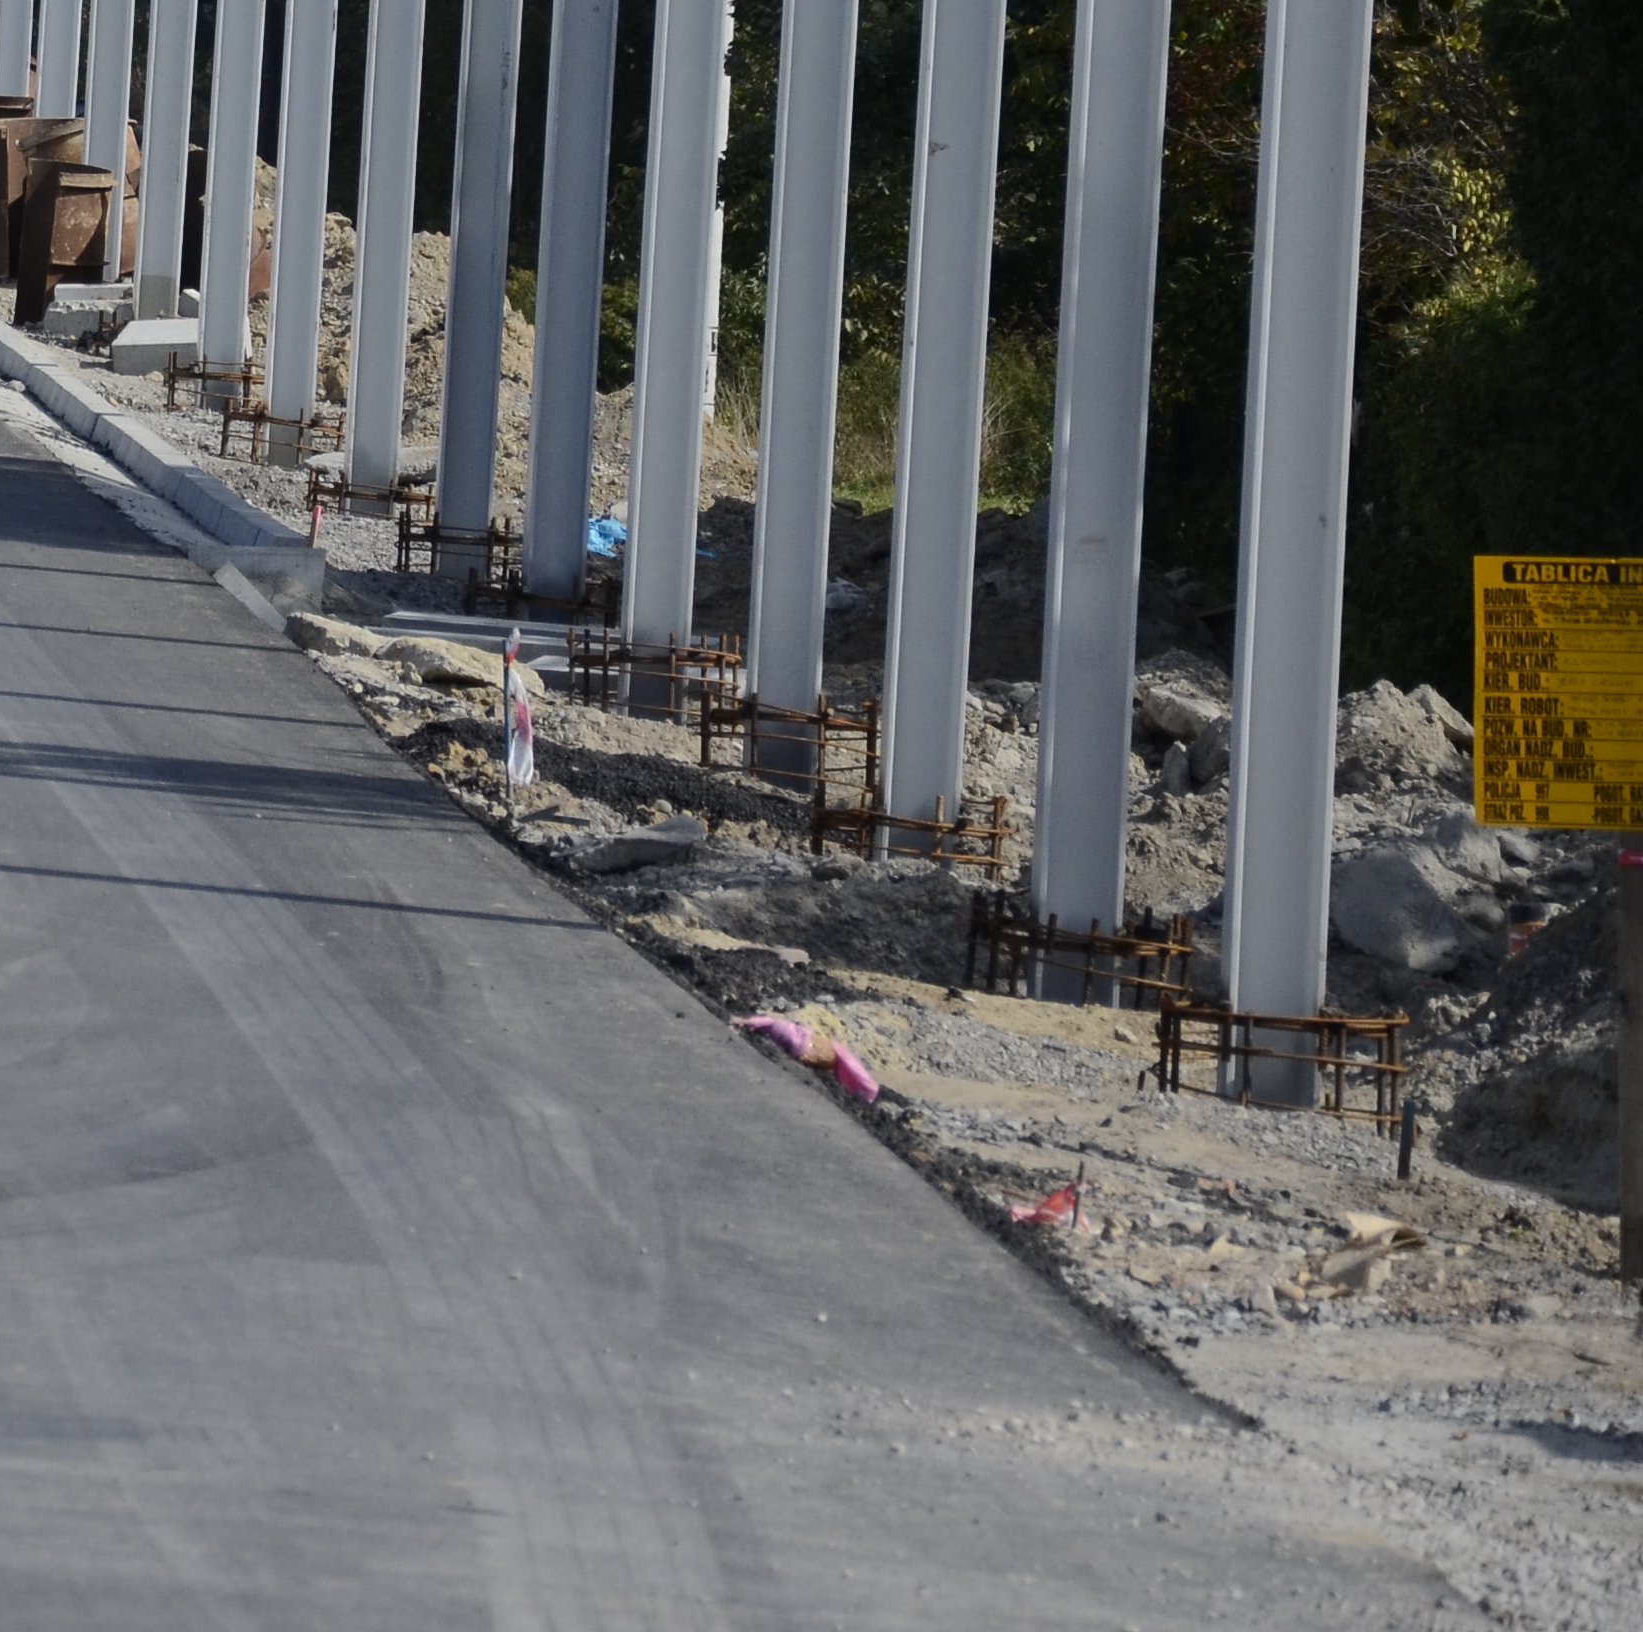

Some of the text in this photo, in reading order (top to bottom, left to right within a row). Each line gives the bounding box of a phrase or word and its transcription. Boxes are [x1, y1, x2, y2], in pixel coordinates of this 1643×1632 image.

[1512, 564, 1609, 582] TABLICA
[1484, 587, 1530, 605] BUDOWA:
[1484, 609, 1537, 627] INWESTOR:
[1485, 630, 1559, 649] WYKONAWCA:
[1485, 651, 1558, 670] PROJEKTANT:
[1484, 672, 1514, 690] KIER.
[1484, 696, 1515, 714] KIER.
[1520, 697, 1564, 715] ROBOT:
[1522, 719, 1537, 737] NA
[1484, 739, 1521, 756] ORGAN
[1484, 760, 1511, 778] INSP.
[1484, 781, 1521, 799] POLICJA
